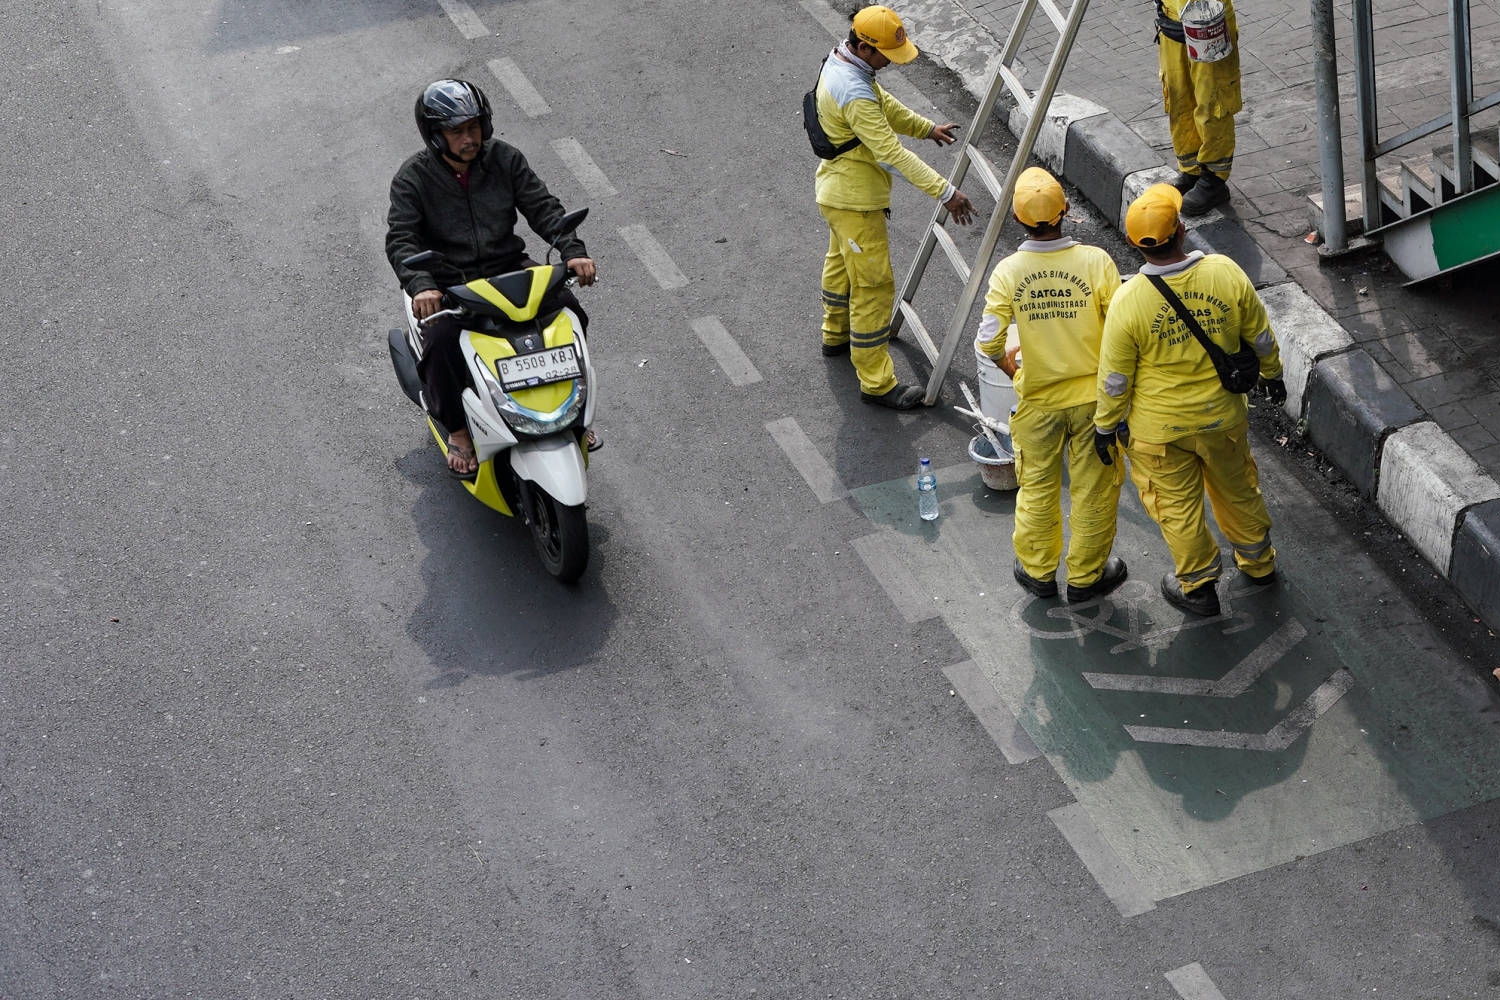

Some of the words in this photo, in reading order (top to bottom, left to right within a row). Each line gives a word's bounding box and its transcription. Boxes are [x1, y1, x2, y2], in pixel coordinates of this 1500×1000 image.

[1013, 282, 1027, 303] SUKU
[1024, 270, 1048, 285] DINAS
[1050, 270, 1069, 280] BINA
[1069, 275, 1092, 297] MARGA
[1030, 288, 1072, 299] SATGAS
[1019, 302, 1036, 312] KOTA
[1037, 300, 1087, 310] ADMINISTRASI
[1151, 312, 1165, 334] SUKU
[1184, 291, 1204, 300] BINA
[1206, 295, 1231, 314] MARGA
[1028, 311, 1055, 321] JAKARTA
[1056, 310, 1077, 319] PUSAT
[1159, 328, 1176, 341] KOTA
[501, 362, 509, 375] B
[515, 355, 546, 372] 5508
[550, 348, 574, 364] KBJ
